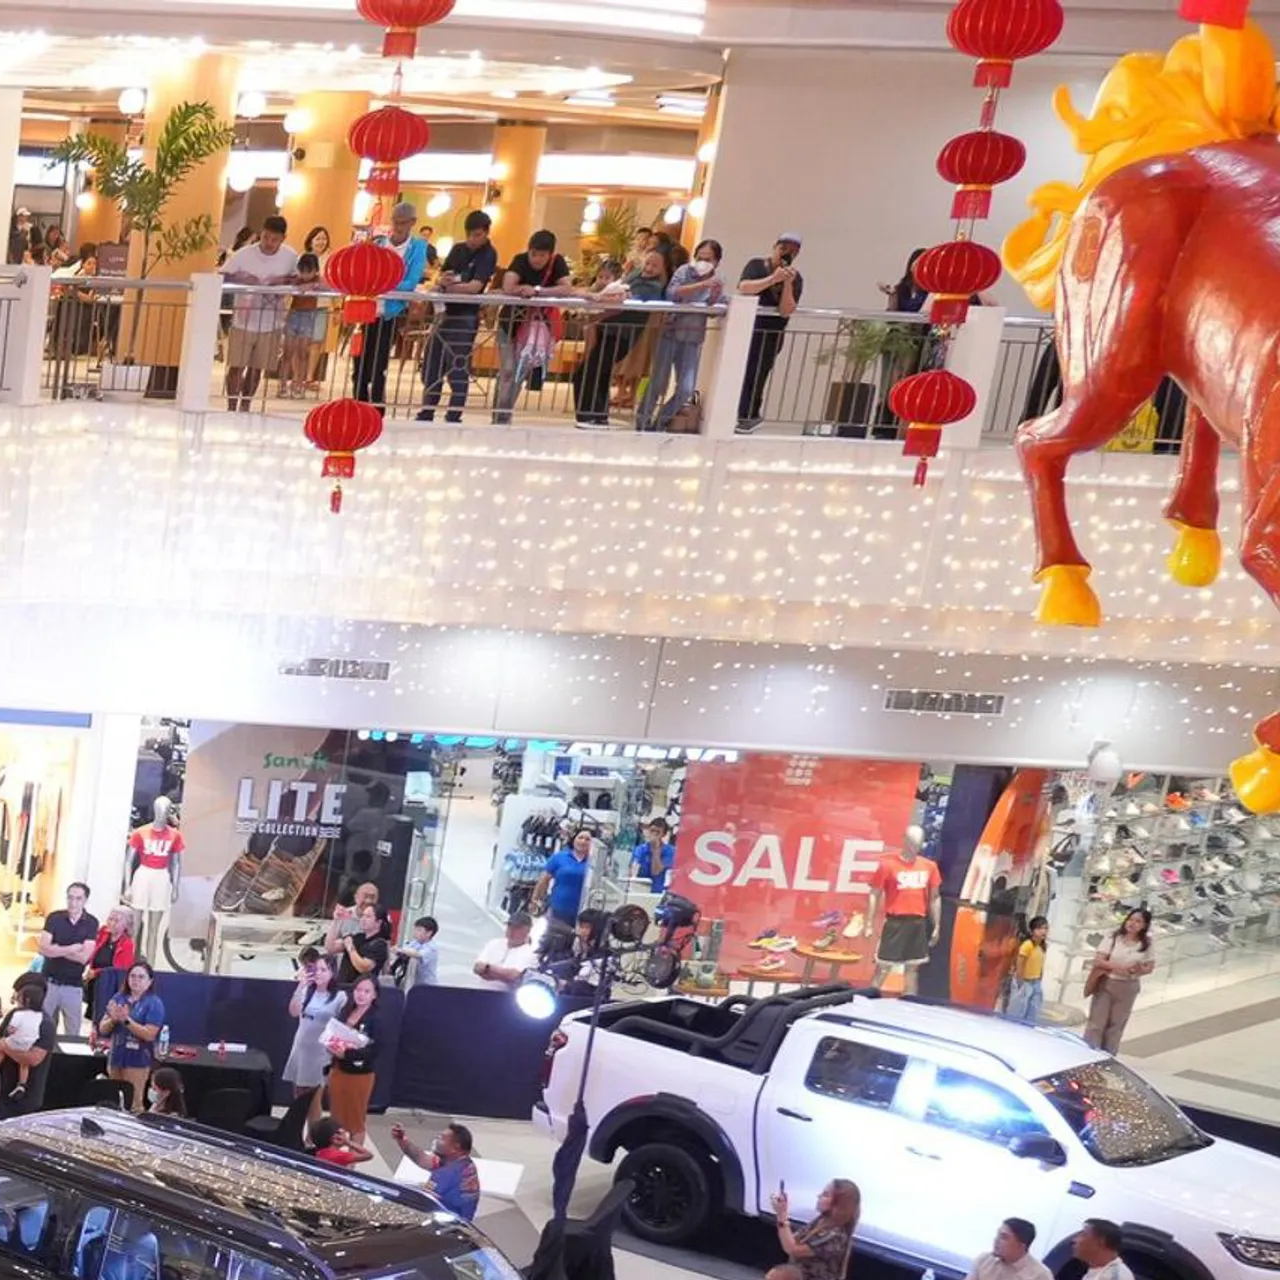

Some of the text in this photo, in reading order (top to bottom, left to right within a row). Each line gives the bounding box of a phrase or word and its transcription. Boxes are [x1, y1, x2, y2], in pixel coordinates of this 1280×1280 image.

[236, 777, 347, 825] LITE
[258, 823, 319, 838] COLLECTION
[689, 830, 885, 894] SALE
